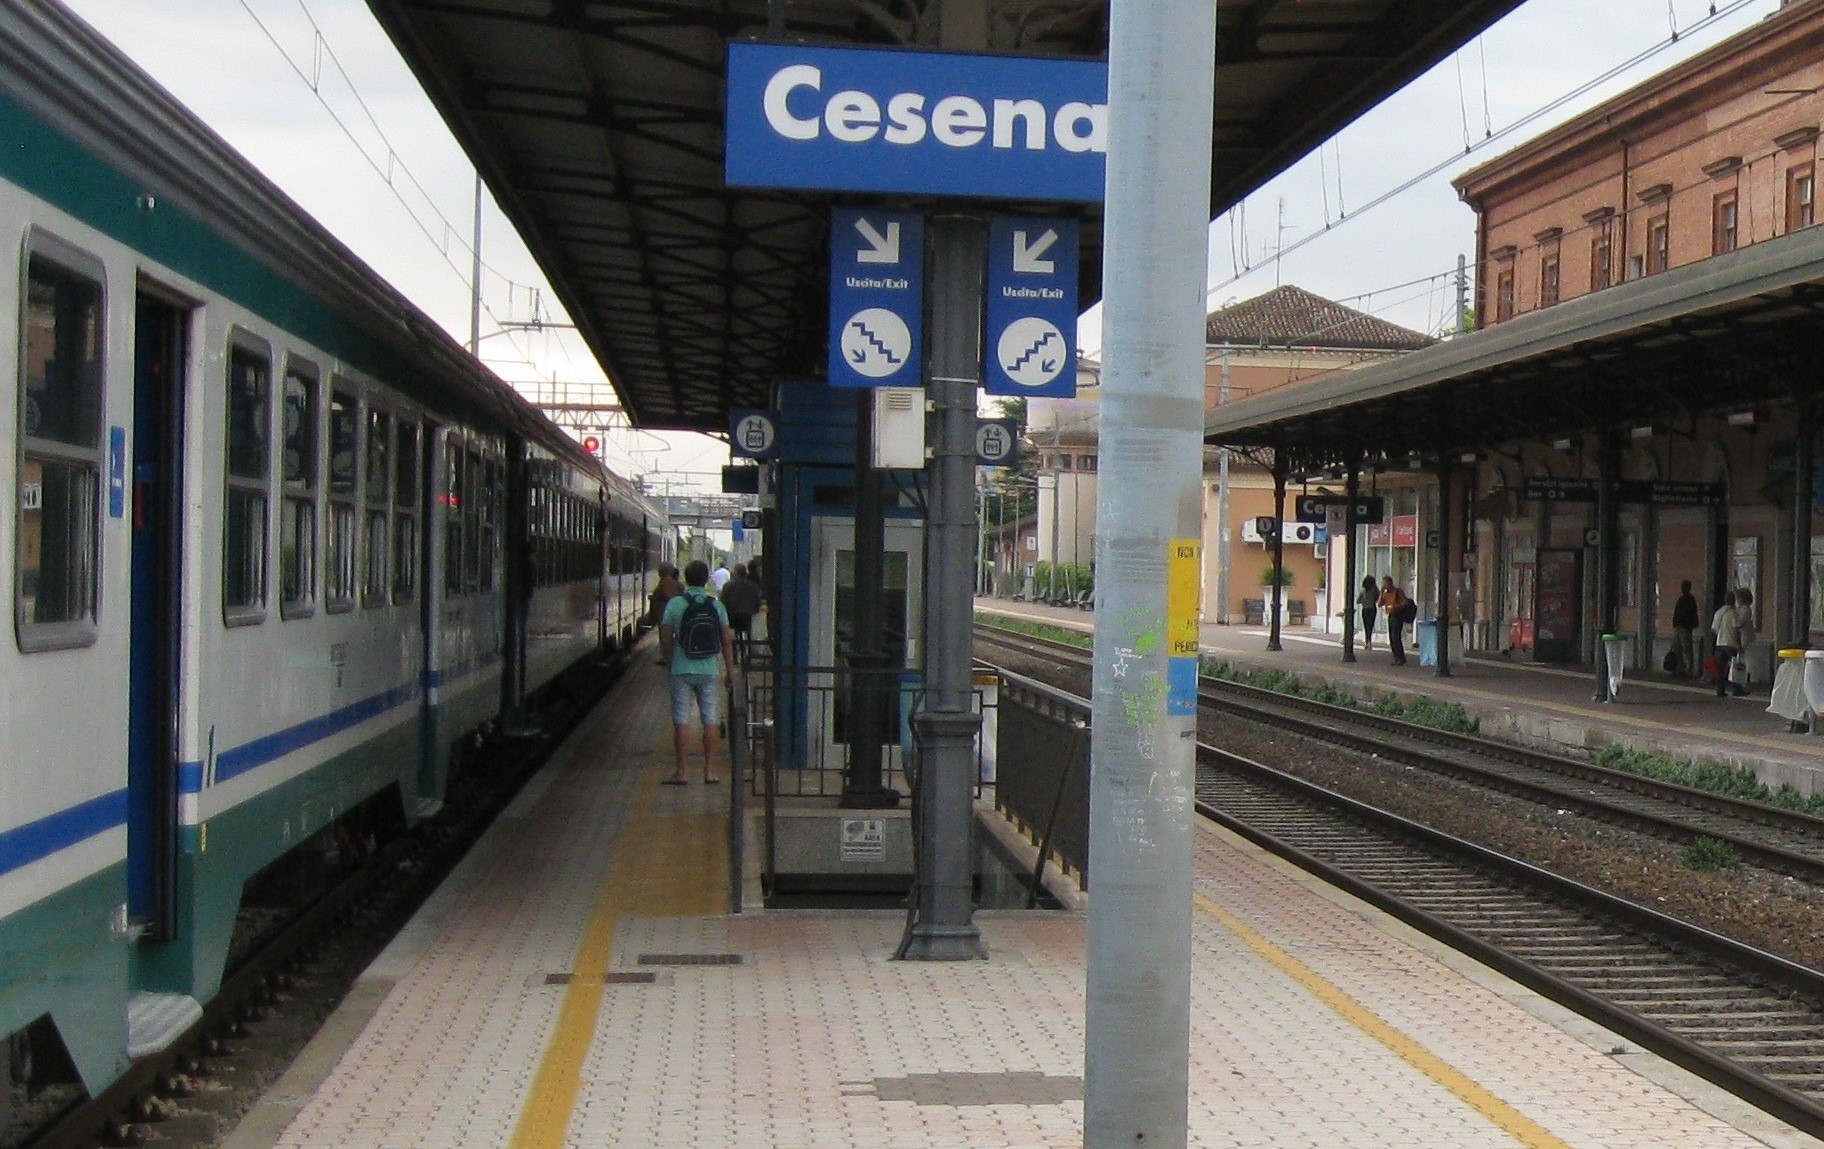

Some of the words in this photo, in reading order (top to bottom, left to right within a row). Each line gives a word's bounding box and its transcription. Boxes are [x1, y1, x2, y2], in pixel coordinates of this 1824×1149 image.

[763, 64, 1109, 153] Cesena
[846, 276, 909, 290] Uscita/Exit
[1002, 286, 1064, 300] Uscita/Exit
[1302, 500, 1368, 516] Cea
